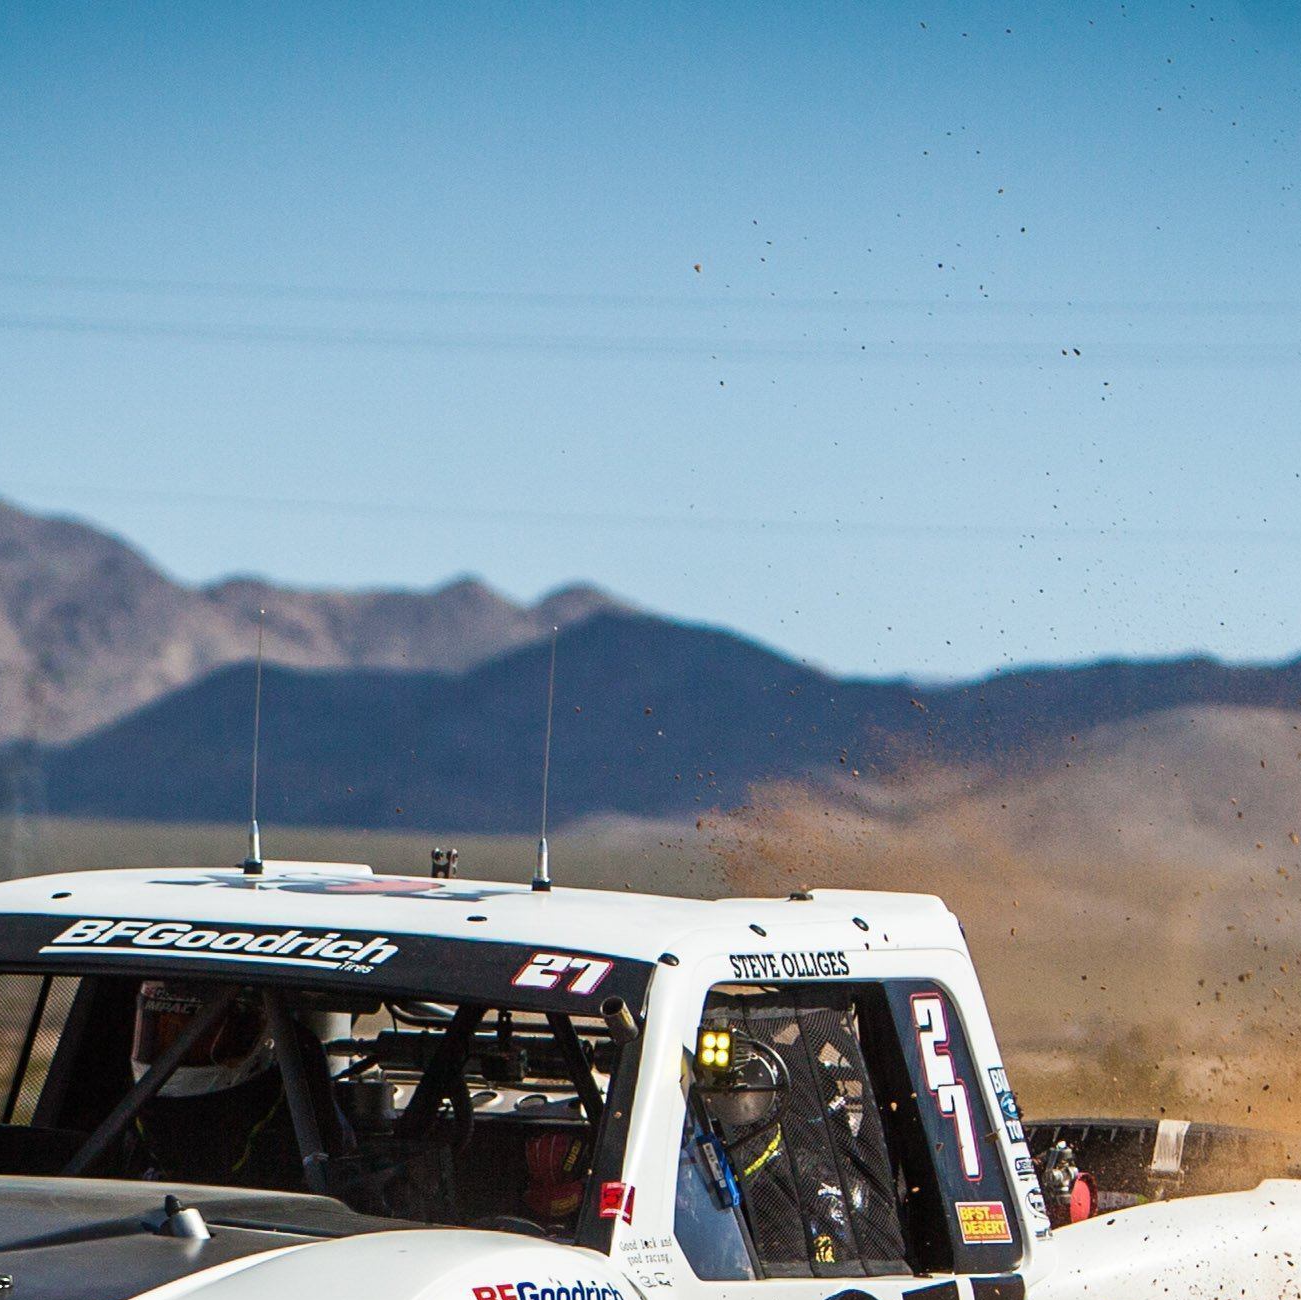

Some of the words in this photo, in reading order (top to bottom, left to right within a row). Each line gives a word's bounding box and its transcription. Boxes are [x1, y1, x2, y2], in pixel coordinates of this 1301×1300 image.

[52, 919, 399, 964] BFGoodrich
[339, 960, 375, 974] Tires
[511, 951, 614, 996] 27
[729, 954, 780, 978] STEVE
[781, 951, 850, 977] OLLIGES
[910, 993, 983, 1181] 27
